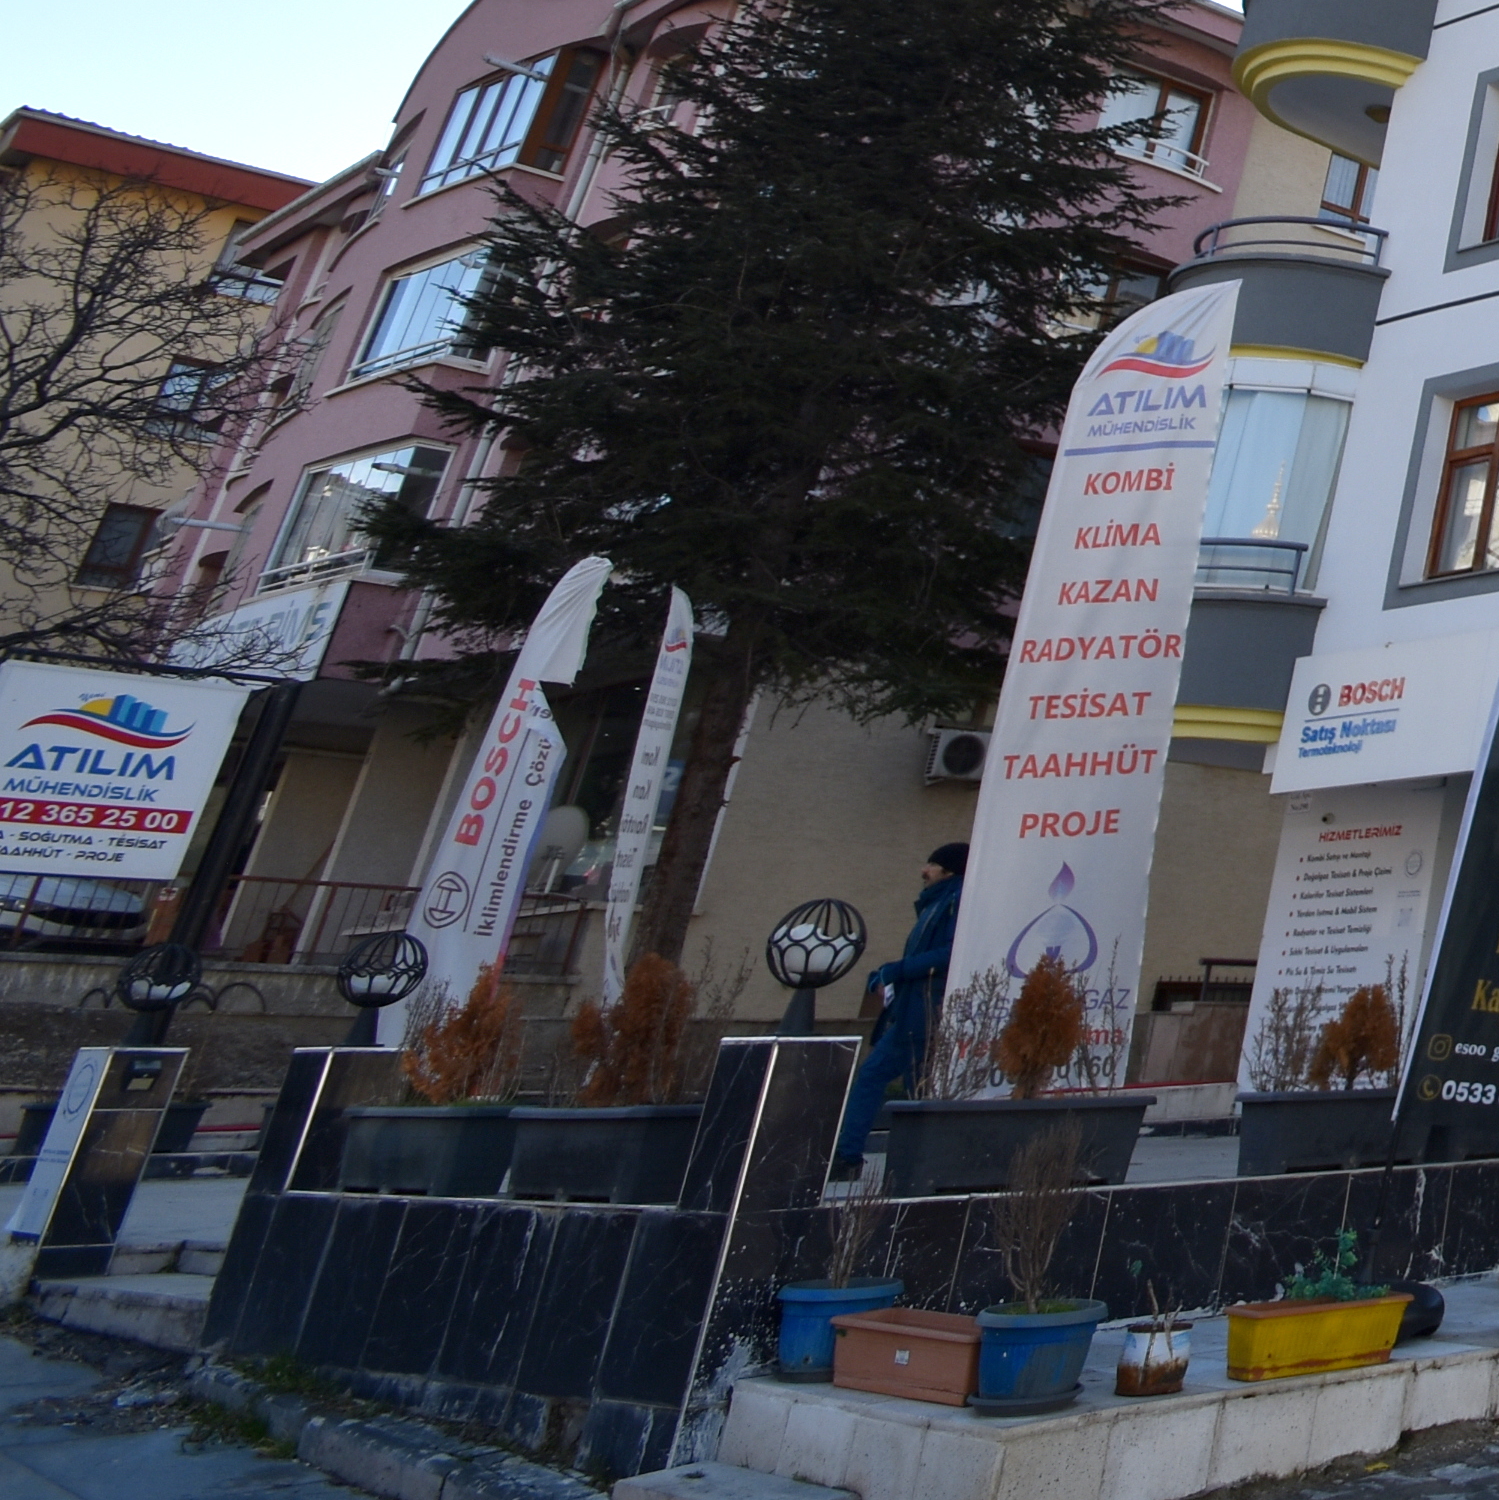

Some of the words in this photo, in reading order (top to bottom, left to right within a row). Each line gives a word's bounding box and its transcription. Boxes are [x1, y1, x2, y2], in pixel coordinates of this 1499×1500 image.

[1087, 384, 1207, 417] ATILIM
[1087, 414, 1197, 437] MÜHENDİSLİK
[1084, 462, 1175, 496] KOMBİ
[1074, 519, 1161, 550] KLİMA
[1058, 578, 1159, 605] KAZAN
[1019, 628, 1182, 663] RADYATÖR
[1029, 688, 1152, 720] TESİSAT
[1338, 676, 1406, 707] BOSCH
[1300, 725, 1336, 744] Satış
[1339, 718, 1397, 739] Noktası
[4, 743, 176, 781] ATILIM
[454, 678, 536, 846] BOSCH
[1003, 743, 1158, 779] TAAHHÜT
[1298, 740, 1363, 759] Termoteknoloji
[2, 776, 159, 802] MÜHENDİSLİK
[42, 804, 95, 825] 365
[101, 807, 136, 828] 25
[144, 812, 179, 831] 00
[1019, 809, 1121, 839] PROJE
[18, 830, 93, 846] SOĞUTMA
[473, 799, 532, 937] İklimlendirme
[525, 738, 553, 787] Çözü
[1318, 824, 1403, 843] HİZMETLERİMİZ
[74, 851, 125, 863] PROJE
[1455, 1042, 1486, 1056] esoo
[1441, 1079, 1496, 1105] 0533
